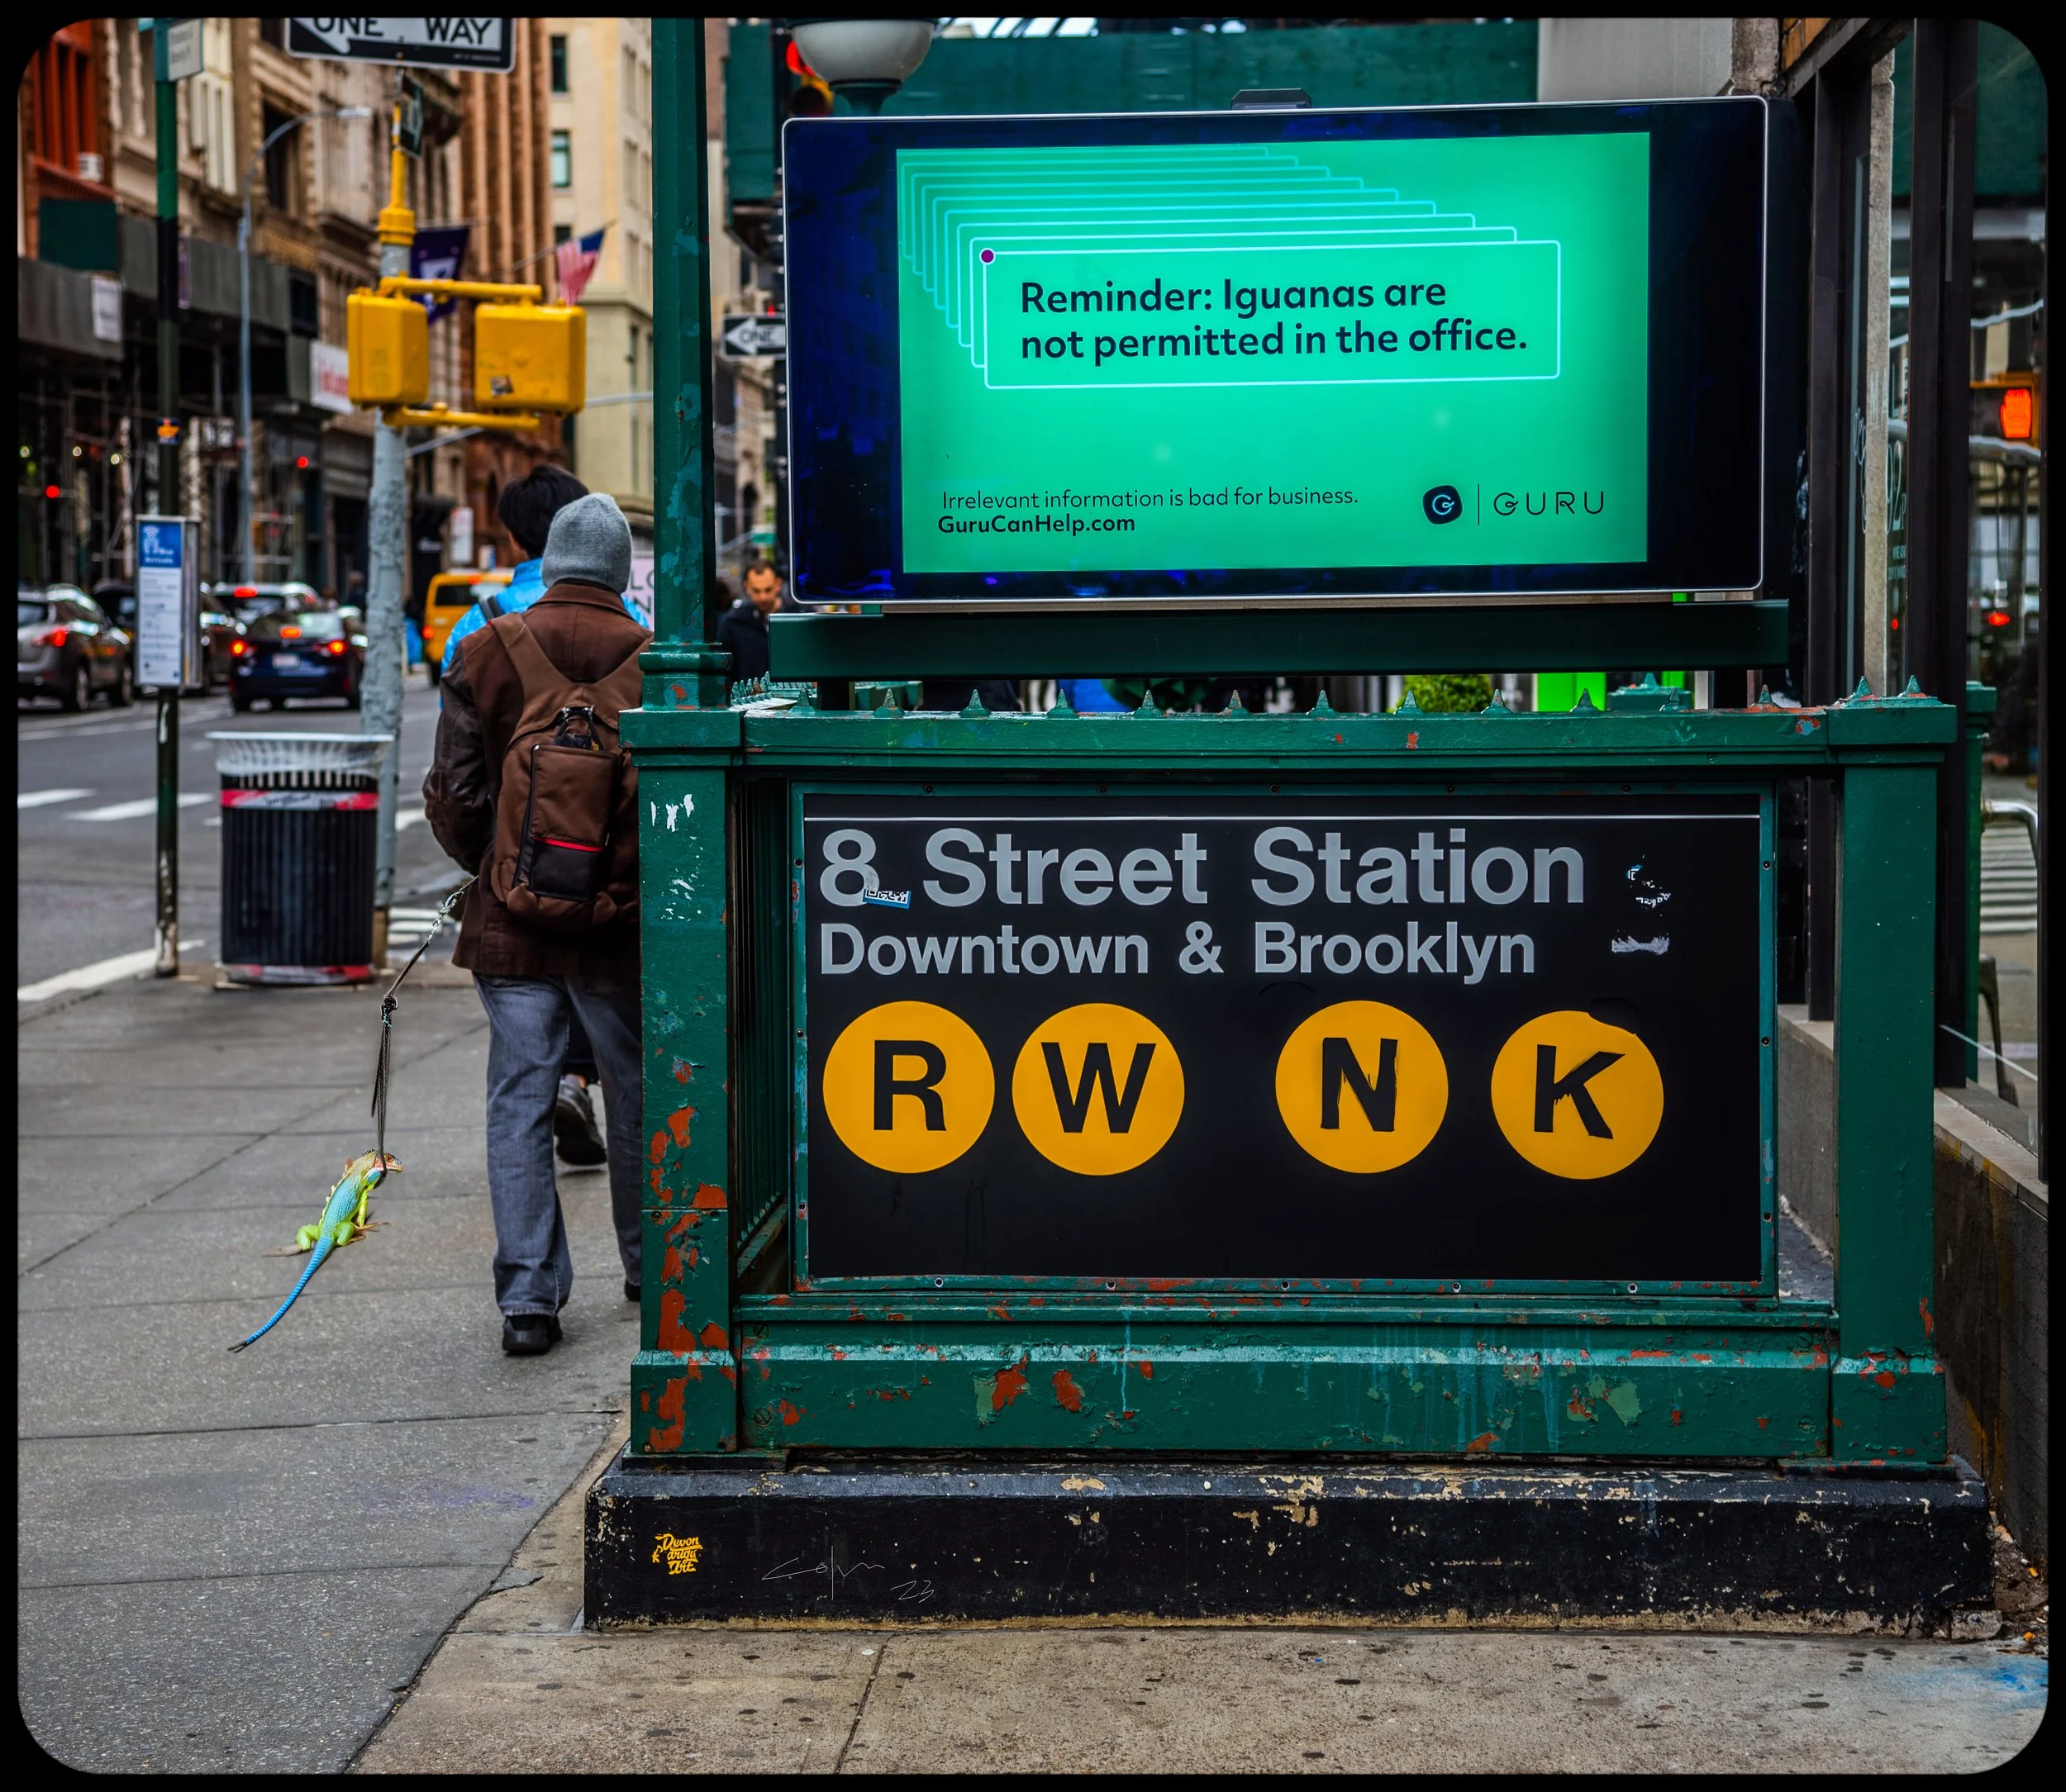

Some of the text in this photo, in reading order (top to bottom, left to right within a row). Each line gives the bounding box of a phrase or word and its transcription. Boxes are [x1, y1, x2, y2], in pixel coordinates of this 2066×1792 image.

[312, 17, 493, 45] ONE WAY
[1021, 278, 1446, 319] Reminder: Iguanas are
[1021, 317, 1527, 367] not permitted in the office.
[942, 486, 1358, 509] Irrelevant information is bad for business.
[1493, 491, 1604, 516] GURU
[938, 512, 1135, 537] GuruCanHelp.com
[820, 826, 1584, 907] 8 Street Station
[821, 921, 1535, 985] Downtown & Brooklyn
[874, 1037, 1626, 1139] R W N K
[655, 1533, 700, 1551] Devon
